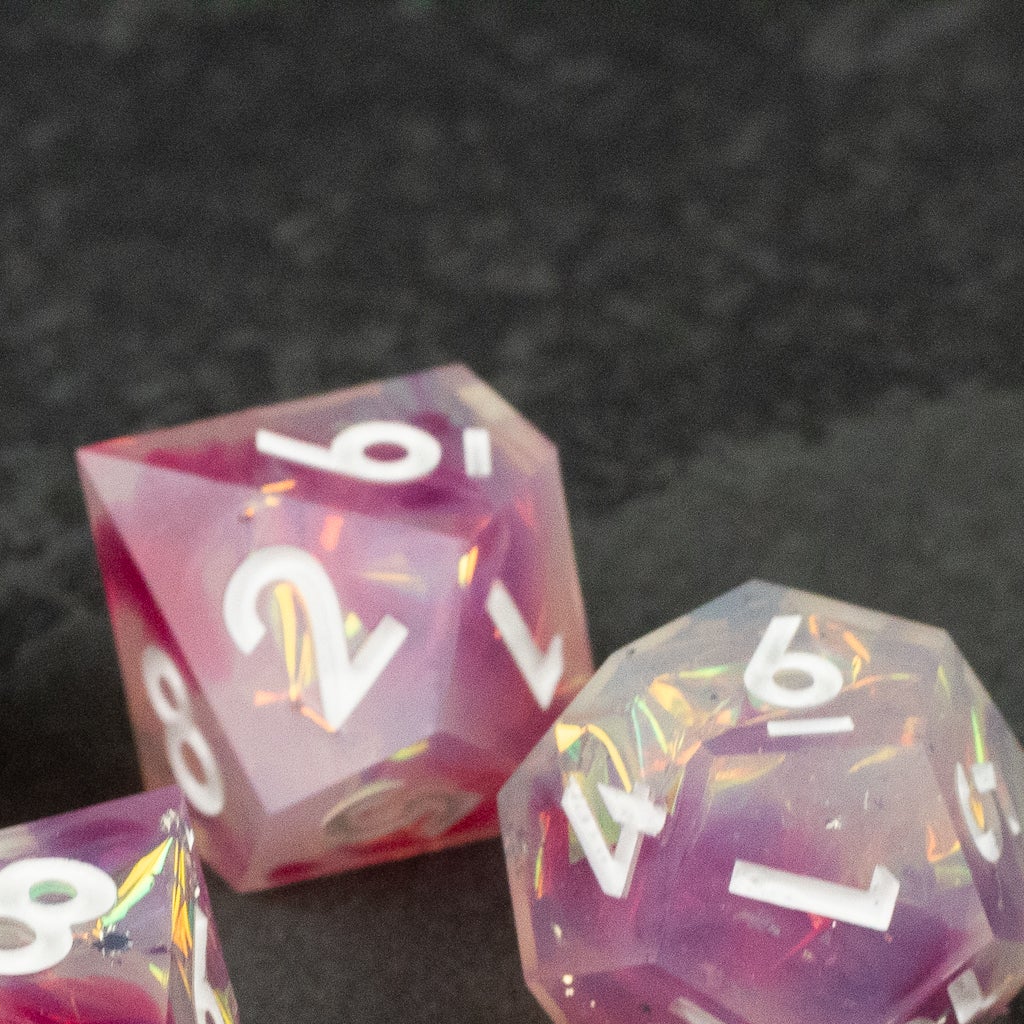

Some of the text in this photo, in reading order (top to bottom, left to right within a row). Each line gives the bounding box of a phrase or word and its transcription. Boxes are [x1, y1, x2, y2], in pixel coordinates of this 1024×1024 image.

[223, 545, 409, 732] 2
[744, 615, 844, 707] 6
[140, 645, 224, 817] 8
[561, 774, 667, 899] 4
[729, 859, 900, 932] 1
